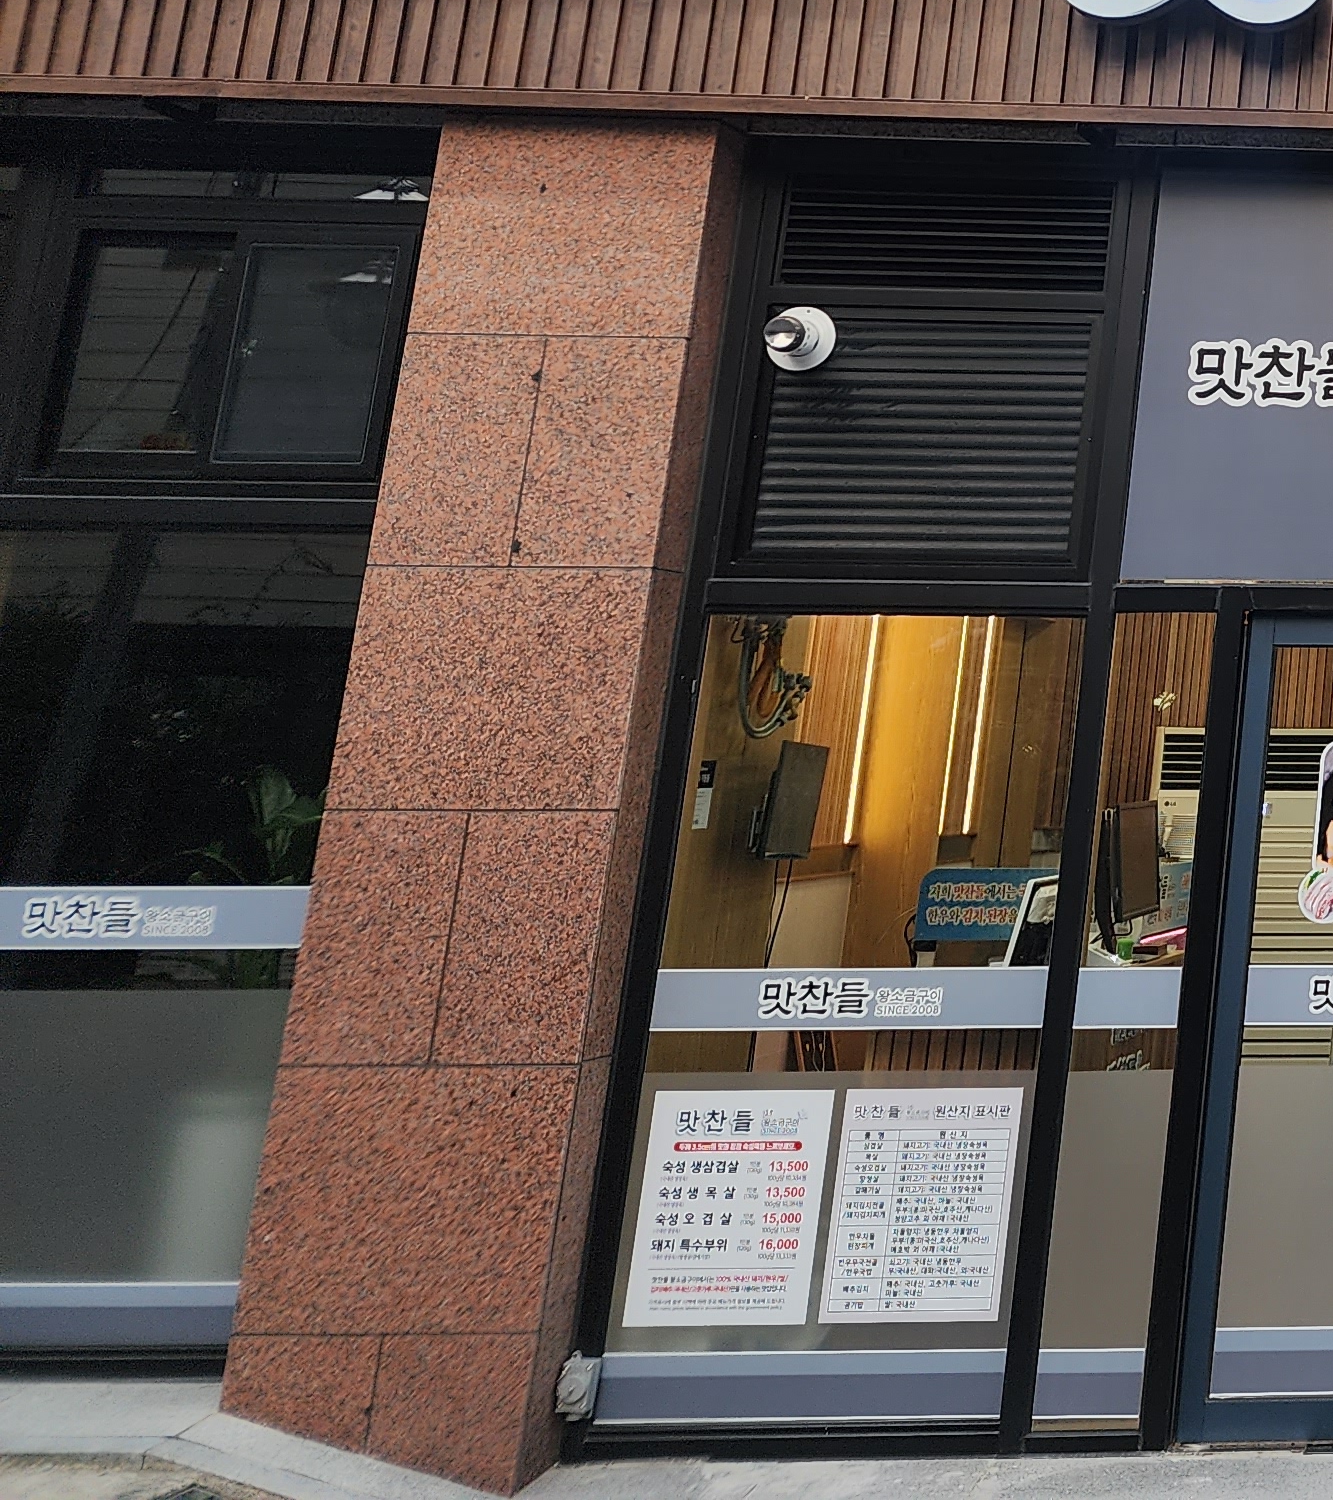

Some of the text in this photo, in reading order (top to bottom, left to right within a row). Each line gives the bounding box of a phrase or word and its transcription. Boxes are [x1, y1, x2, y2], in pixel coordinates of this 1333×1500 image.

[26, 899, 138, 935] 맛찬들
[763, 980, 942, 1016] 맛찬들 왕소금구이
[911, 1004, 940, 1016] 2008
[854, 1105, 901, 1119] 맛찬들
[934, 1104, 970, 1119] 원산지
[974, 1104, 1011, 1119] 표시판
[677, 1109, 755, 1133] 맛찬들
[662, 1160, 686, 1174] 숙성
[690, 1160, 740, 1174] 생삼겹살
[768, 1160, 809, 1173] 13,500
[658, 1186, 683, 1200] 숙성
[765, 1186, 806, 1199] 13,500
[654, 1212, 679, 1226] 숙성
[761, 1212, 802, 1225] 15,000
[650, 1238, 675, 1253] 돼지
[679, 1238, 728, 1253] 특수부위
[758, 1238, 799, 1251] 16,000
